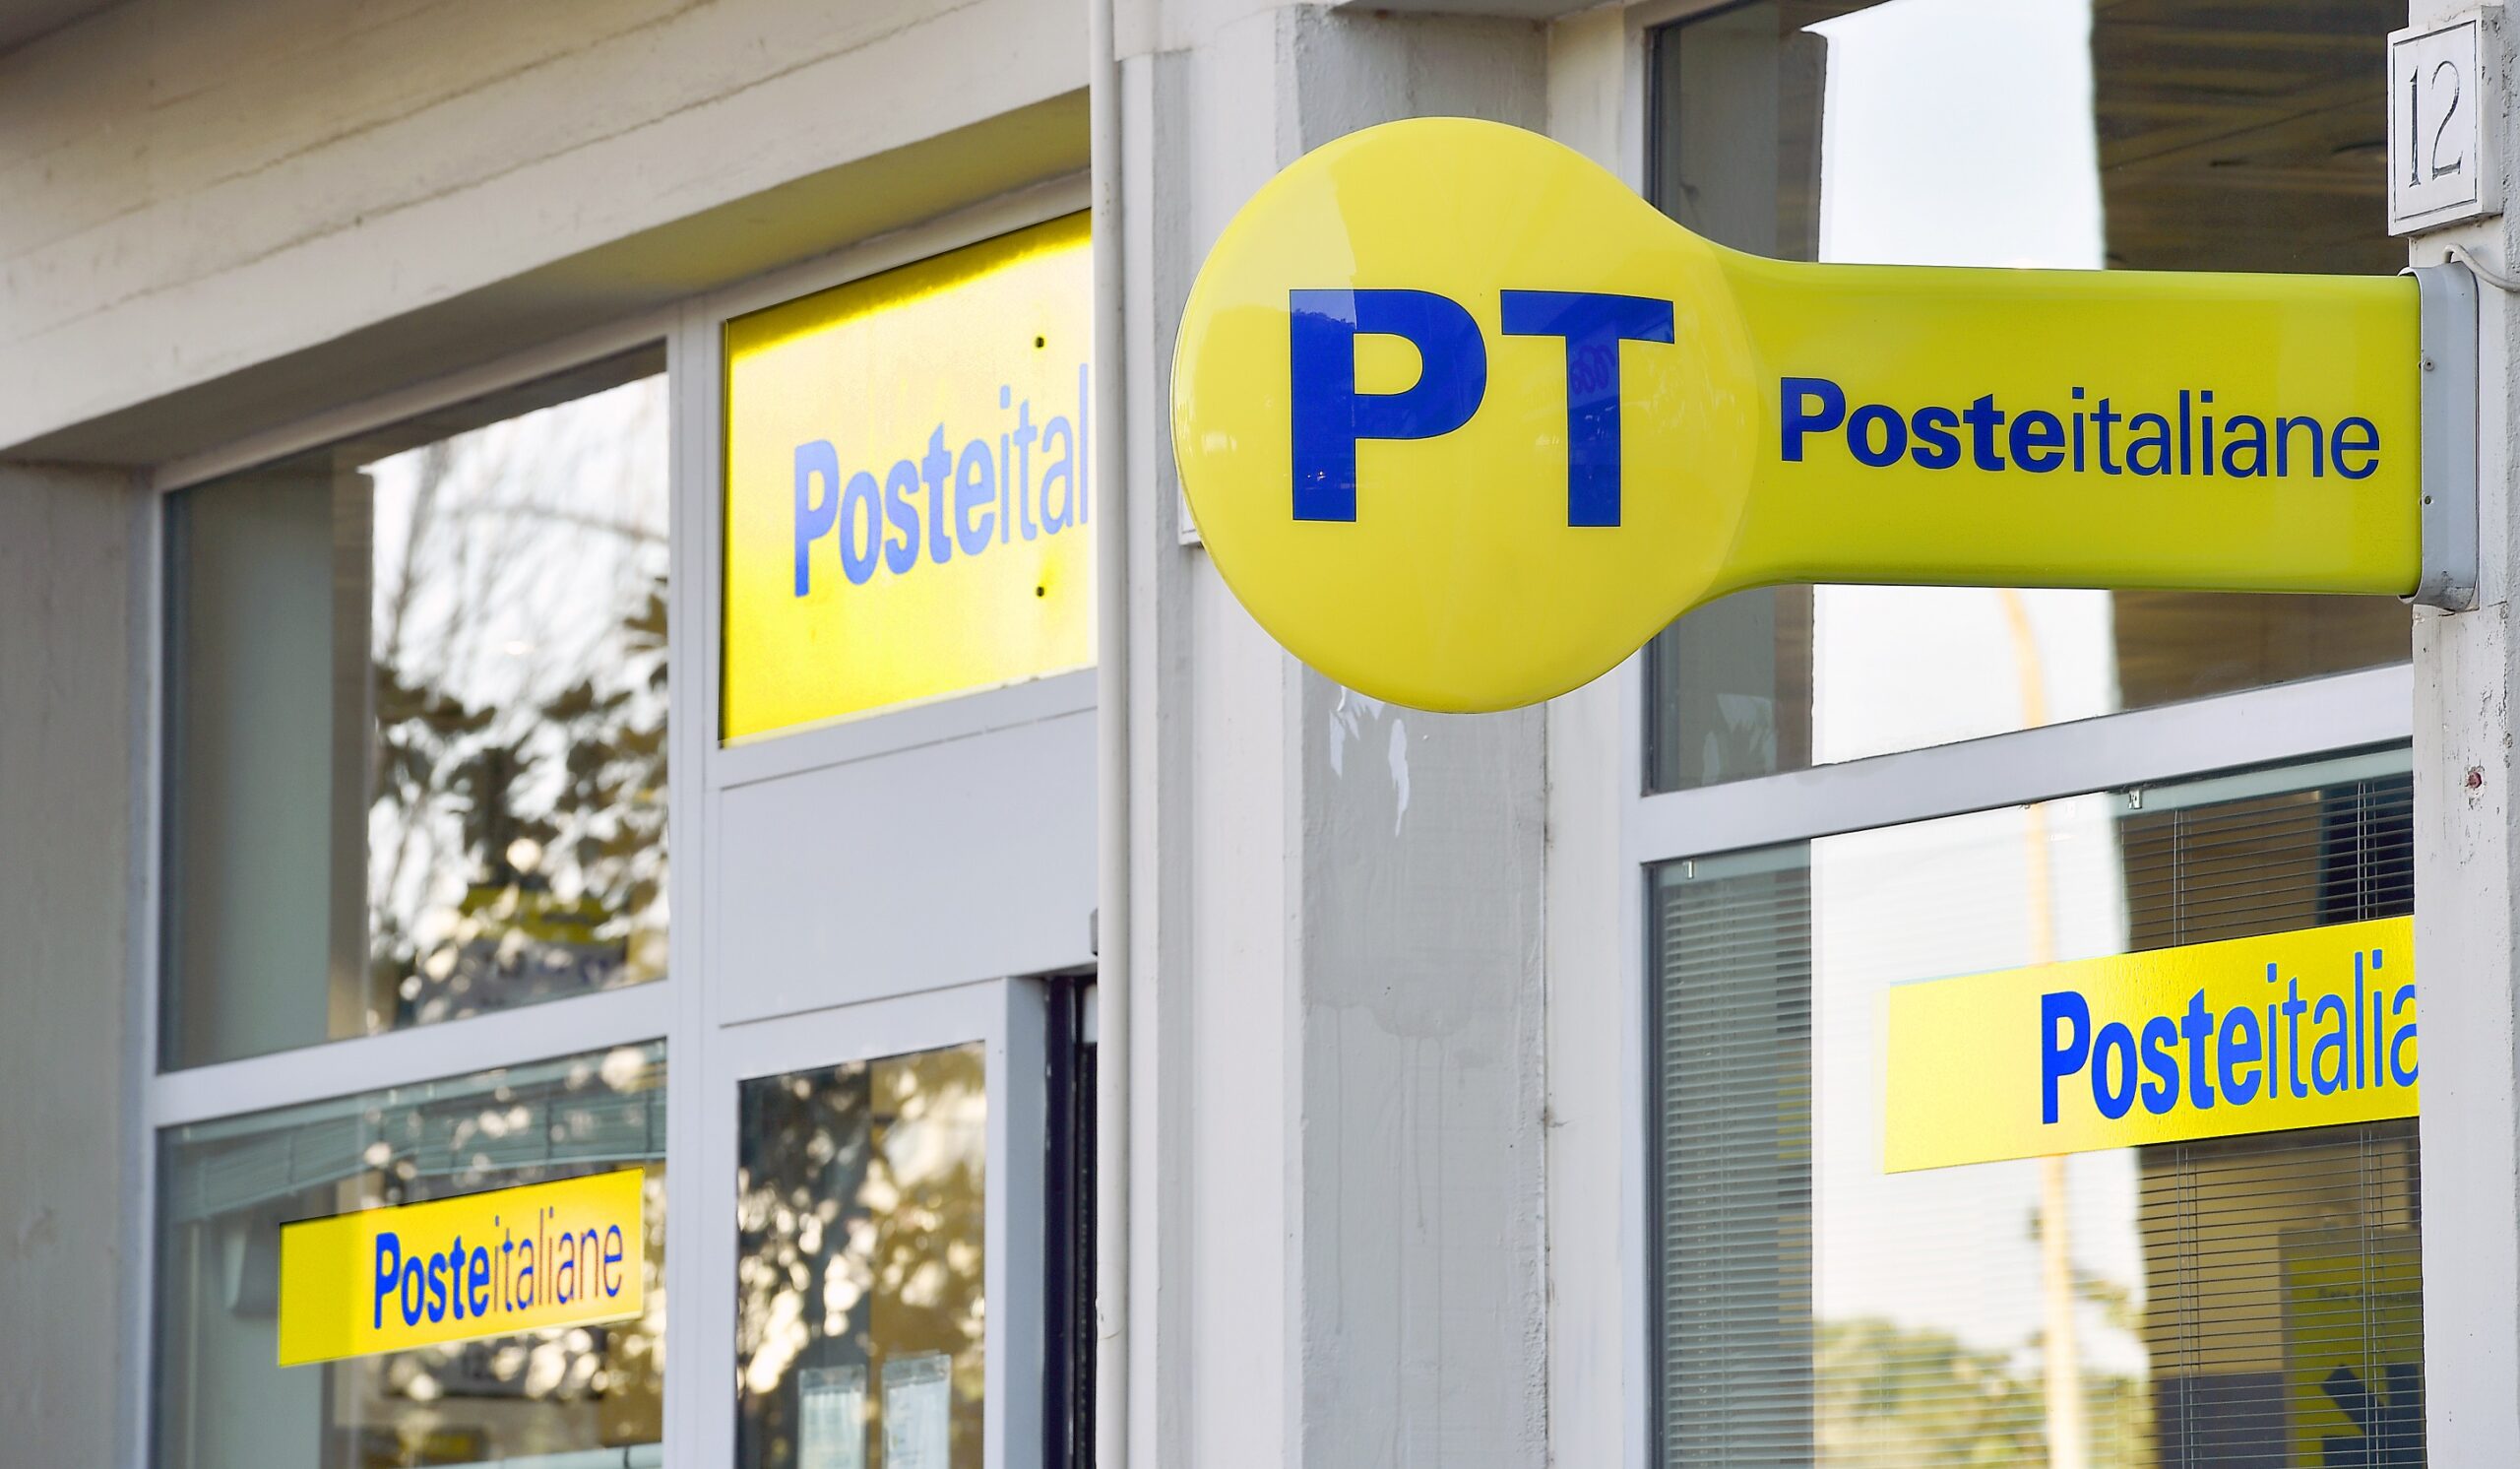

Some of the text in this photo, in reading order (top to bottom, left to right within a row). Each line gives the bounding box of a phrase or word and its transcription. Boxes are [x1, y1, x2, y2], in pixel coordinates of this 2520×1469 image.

[2408, 60, 2464, 189] 12
[1289, 288, 1675, 528] PT
[1780, 377, 2380, 480] Posteitaliane
[374, 1207, 623, 1330] Posteitaliane
